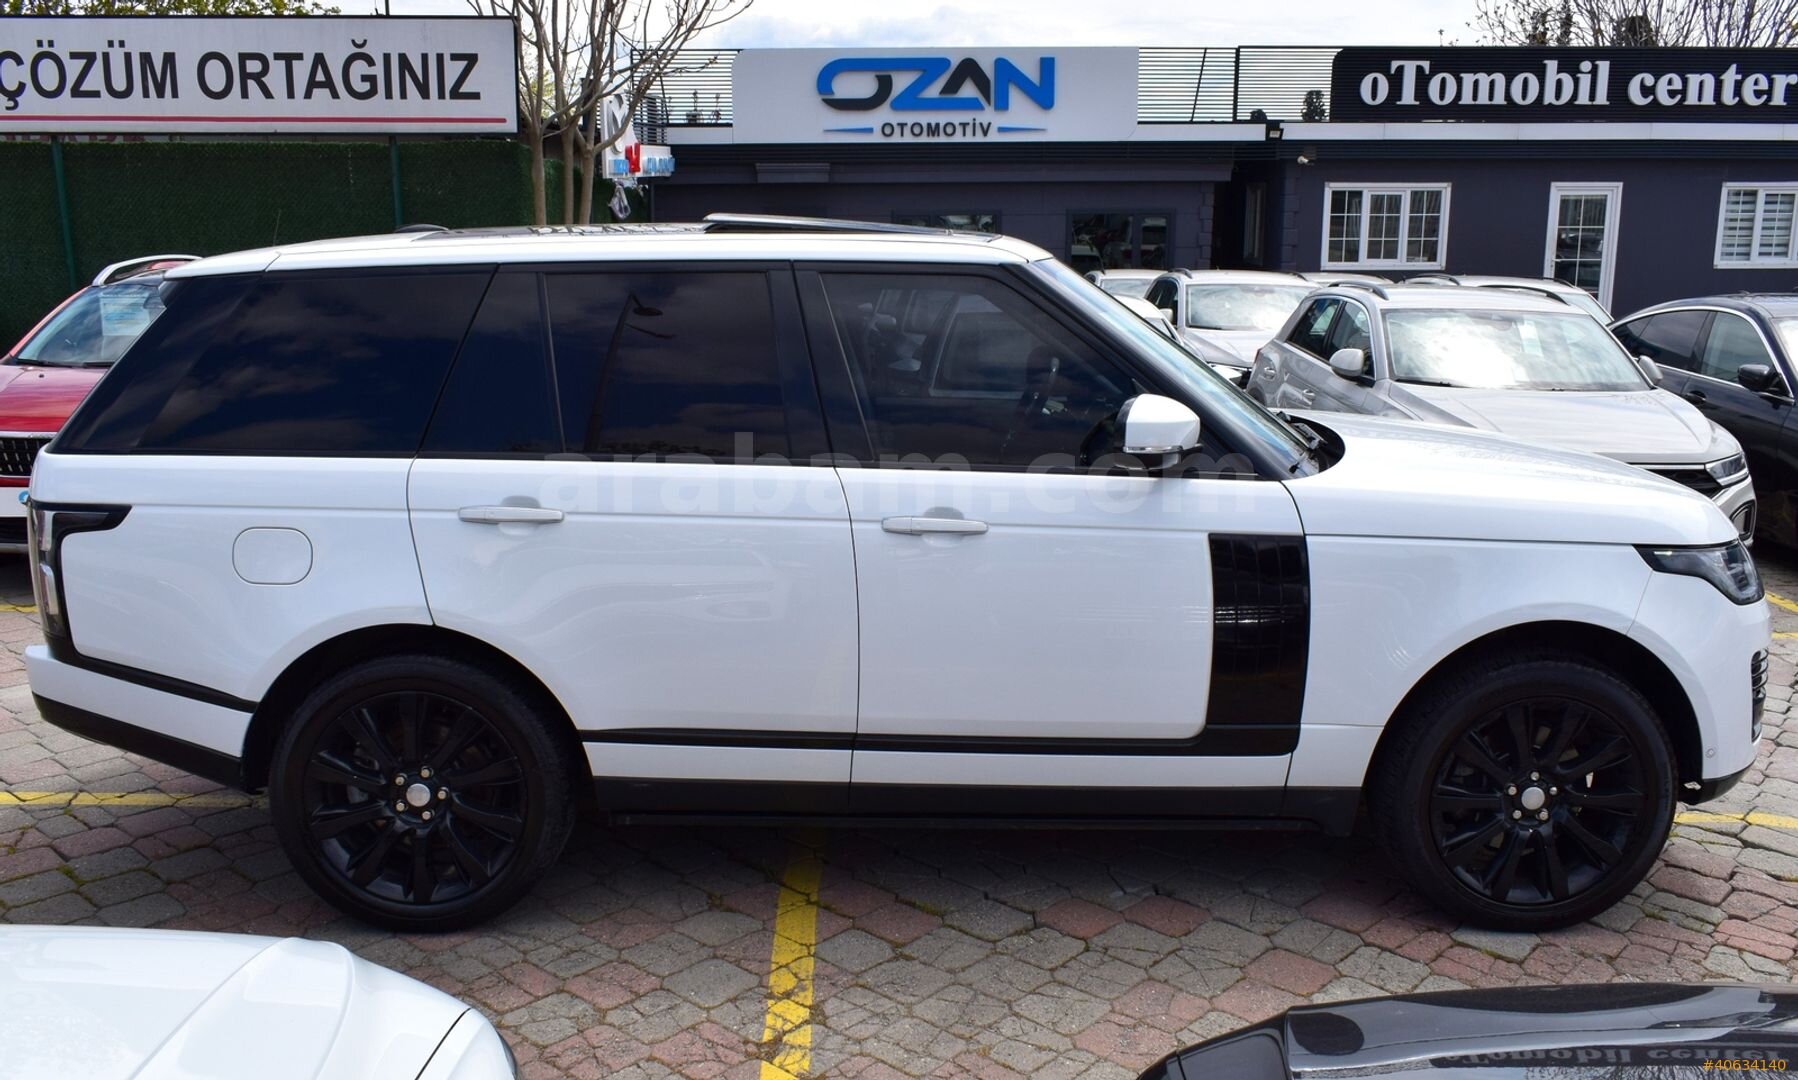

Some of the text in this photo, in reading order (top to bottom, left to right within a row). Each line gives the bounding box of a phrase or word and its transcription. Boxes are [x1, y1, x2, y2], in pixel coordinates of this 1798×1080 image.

[0, 39, 481, 110] ÇÖZÜM ORTAĞINIZ
[816, 57, 1055, 112] OZAN
[1359, 60, 1798, 106] oTomobil center
[881, 118, 992, 137] OTOMOTİV
